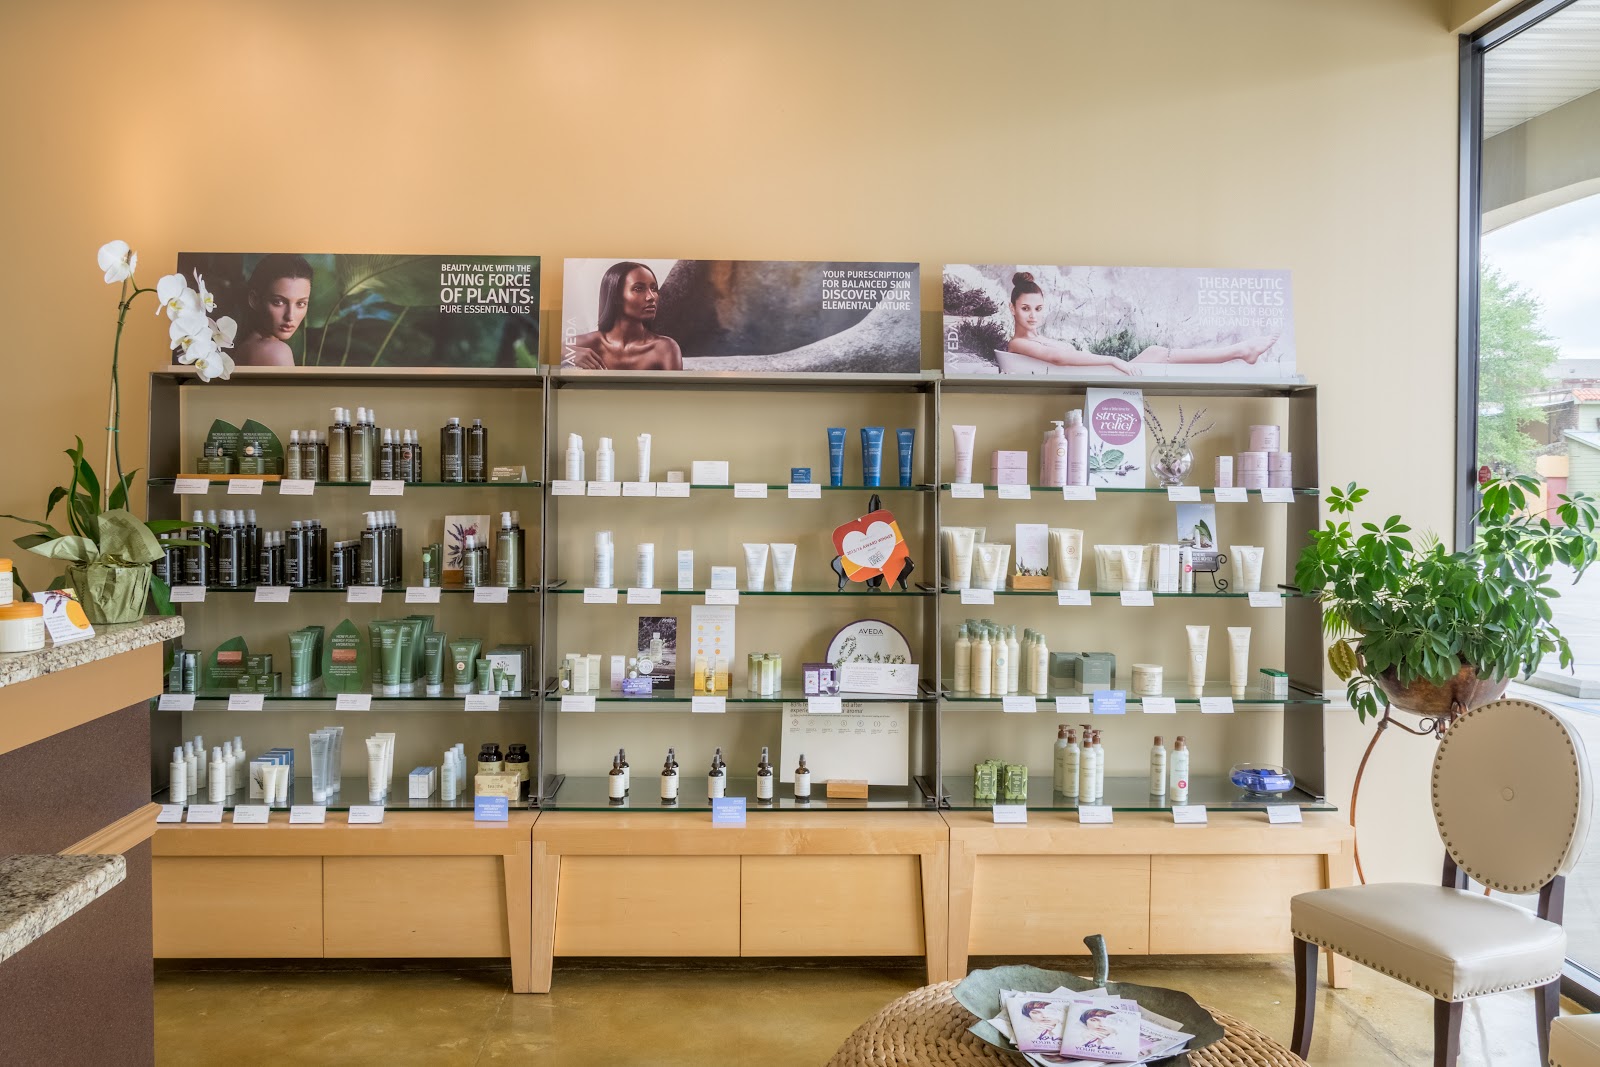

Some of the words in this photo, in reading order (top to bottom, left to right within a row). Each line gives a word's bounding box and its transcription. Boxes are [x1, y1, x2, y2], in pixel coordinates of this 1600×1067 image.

[441, 264, 471, 272] BEAUTY
[472, 264, 494, 272] ALIVE
[495, 264, 515, 273] WITH
[516, 265, 531, 273] THE
[822, 270, 845, 278] YOUR
[440, 273, 484, 286] LIVING
[488, 274, 531, 287] FORCE
[822, 279, 839, 288] FOR
[841, 280, 888, 289] BALANCED
[890, 280, 911, 289] SKIN
[1198, 277, 1284, 290] THERAPEUTIC
[440, 287, 463, 303] OF
[466, 288, 534, 304] PLANTS:
[822, 289, 877, 300] DISCOVER
[880, 290, 911, 300] YOUR
[1198, 290, 1284, 306] ESSENCES
[440, 305, 462, 313] PURE
[464, 305, 508, 314] ESSENTIAL
[511, 305, 530, 314] OILS
[822, 301, 873, 310] ELEMENTAL
[1199, 307, 1236, 316] RITUALS
[1238, 307, 1257, 316] FOR
[1229, 317, 1250, 327] AND
[565, 316, 577, 367] AVEDA
[947, 321, 959, 370] AVEDA
[1095, 411, 1134, 421] stress
[1100, 418, 1138, 431] relief
[1075, 1045, 1096, 1053] YOUR
